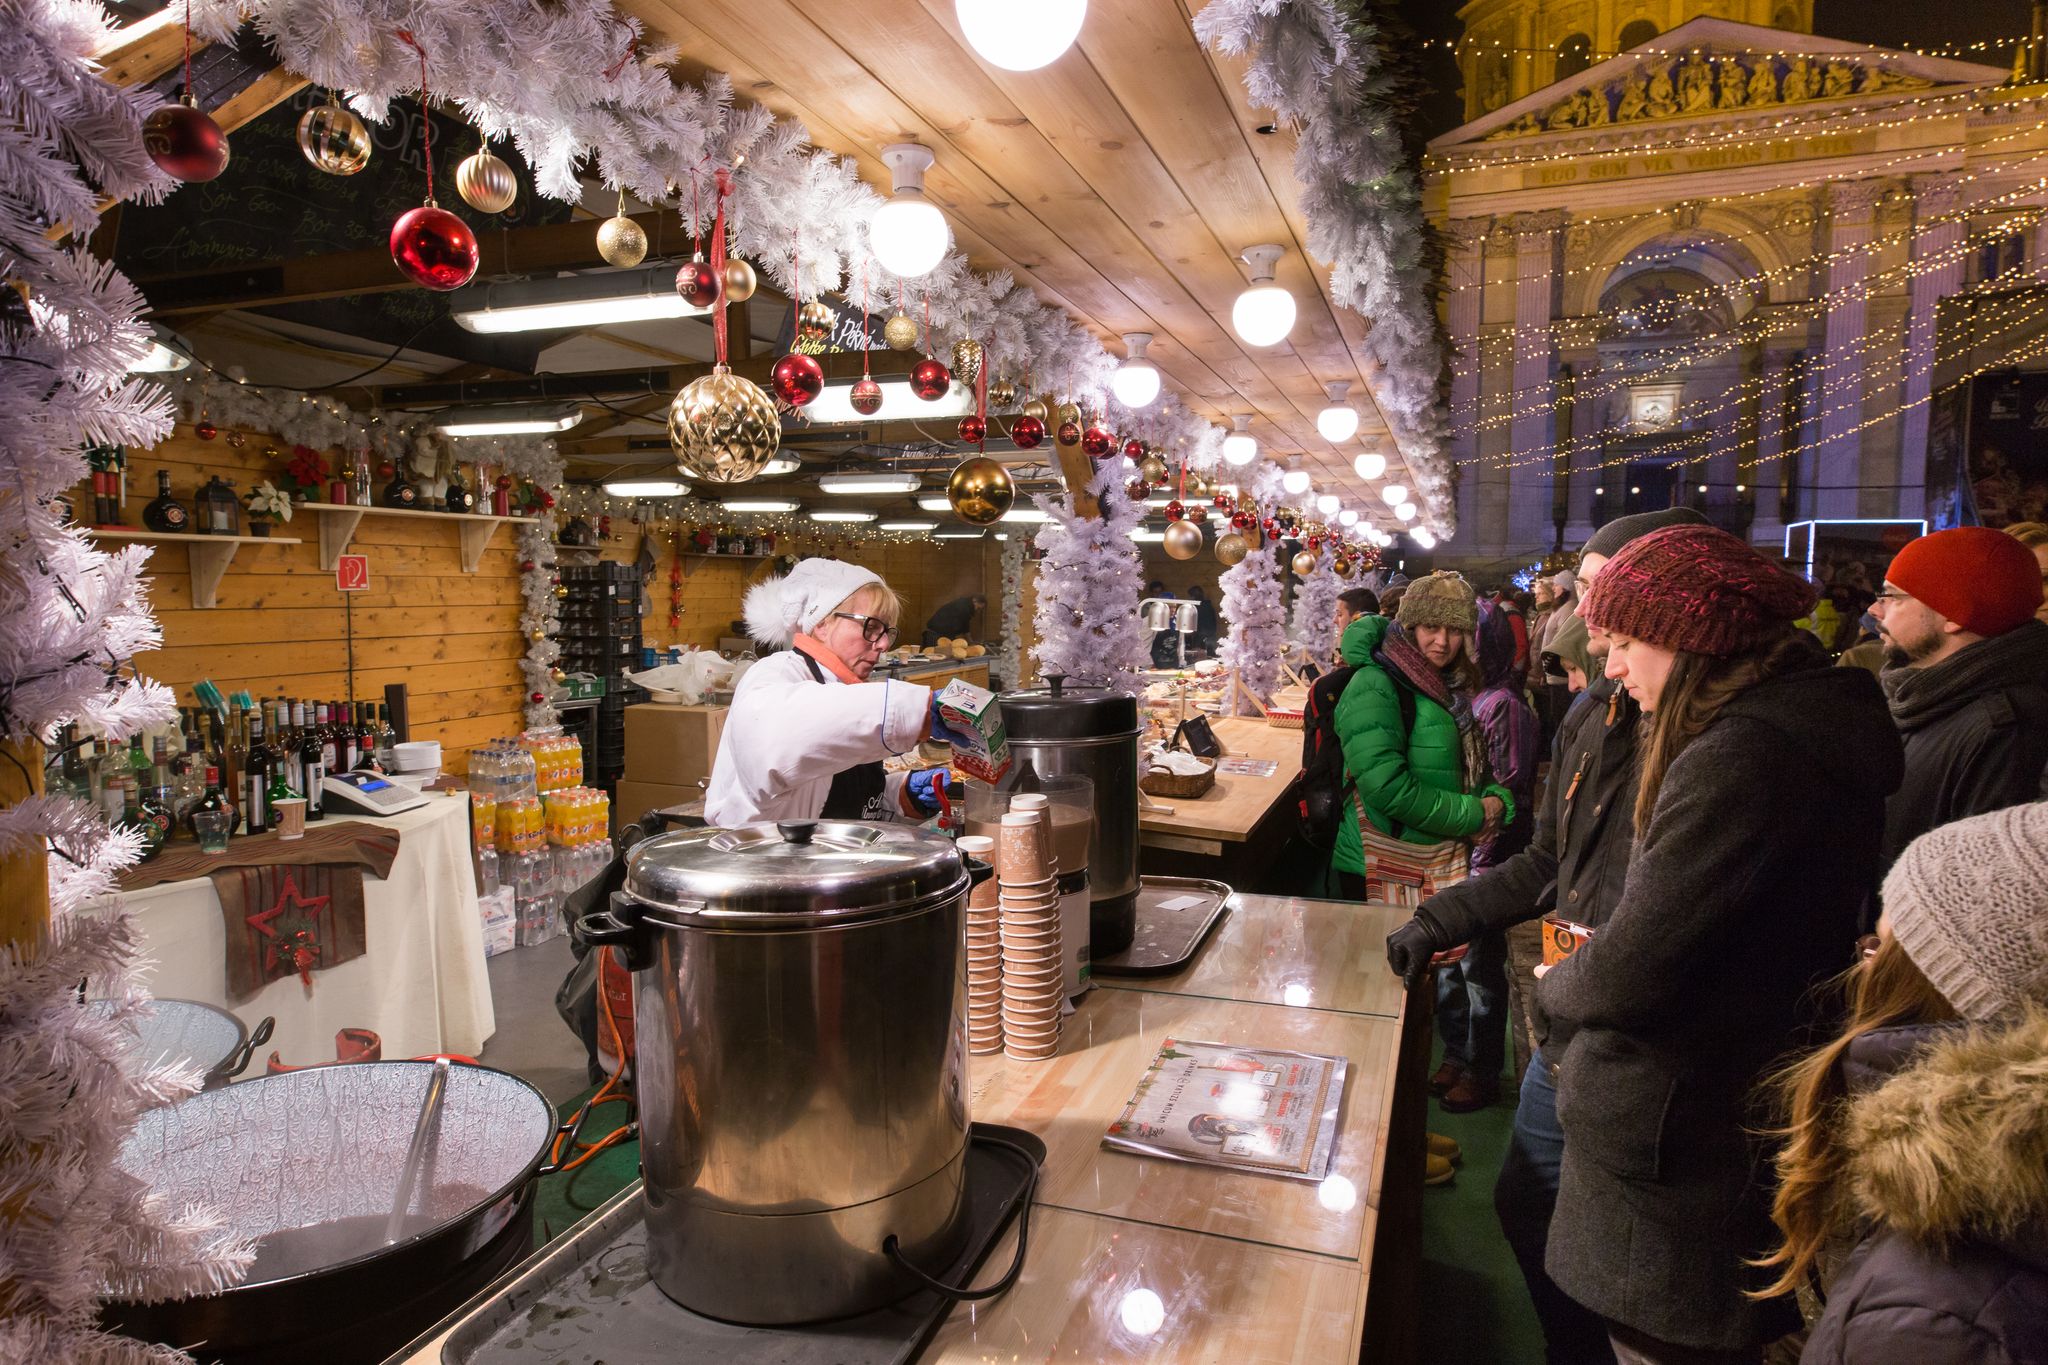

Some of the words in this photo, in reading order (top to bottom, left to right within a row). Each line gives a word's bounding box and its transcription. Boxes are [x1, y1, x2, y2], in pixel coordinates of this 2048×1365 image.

[1540, 167, 1577, 184] EGO
[1589, 161, 1629, 179] SUM
[1644, 157, 1673, 173] VIA
[1686, 149, 1761, 168] VERITAS
[1158, 1103, 1174, 1124] UNICUM
[1169, 1084, 1185, 1102] SZILVA
[1182, 1059, 1198, 1077] DRINKS
